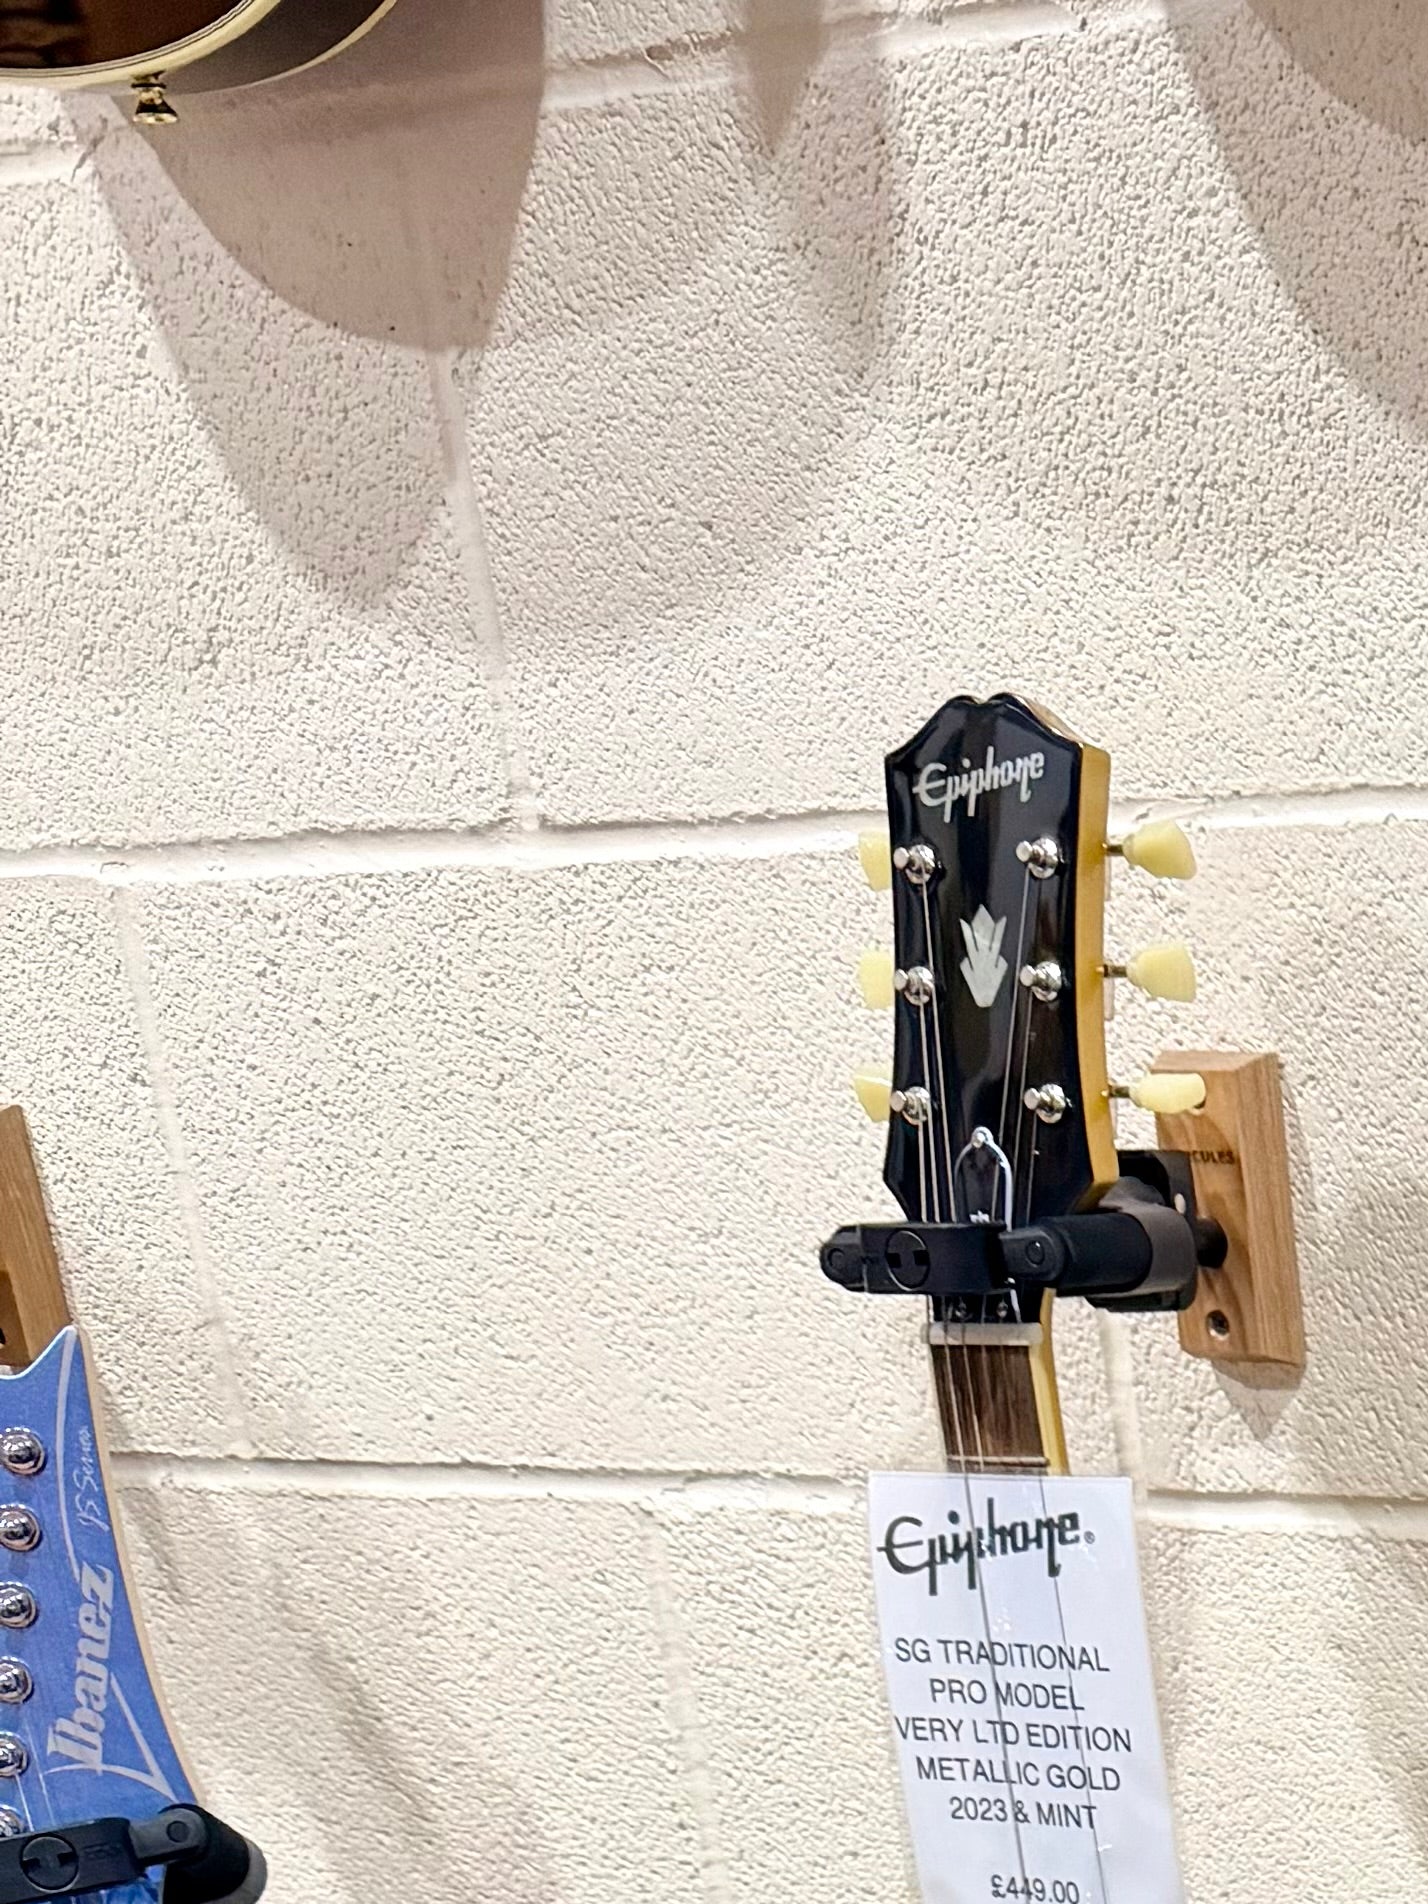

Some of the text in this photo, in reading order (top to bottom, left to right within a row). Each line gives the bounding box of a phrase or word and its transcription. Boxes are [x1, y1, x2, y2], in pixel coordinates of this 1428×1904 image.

[912, 745, 1045, 823] Epiphone
[47, 1560, 115, 1776] Ibanez
[894, 1637, 1110, 1672] SG TRADITIONAL
[929, 1678, 1085, 1711] PRO MODEL
[895, 1716, 1133, 1753] VERY LTD EDITION
[915, 1756, 1121, 1792] METALLIC GOLD
[949, 1796, 1098, 1830] 2023 & MINT
